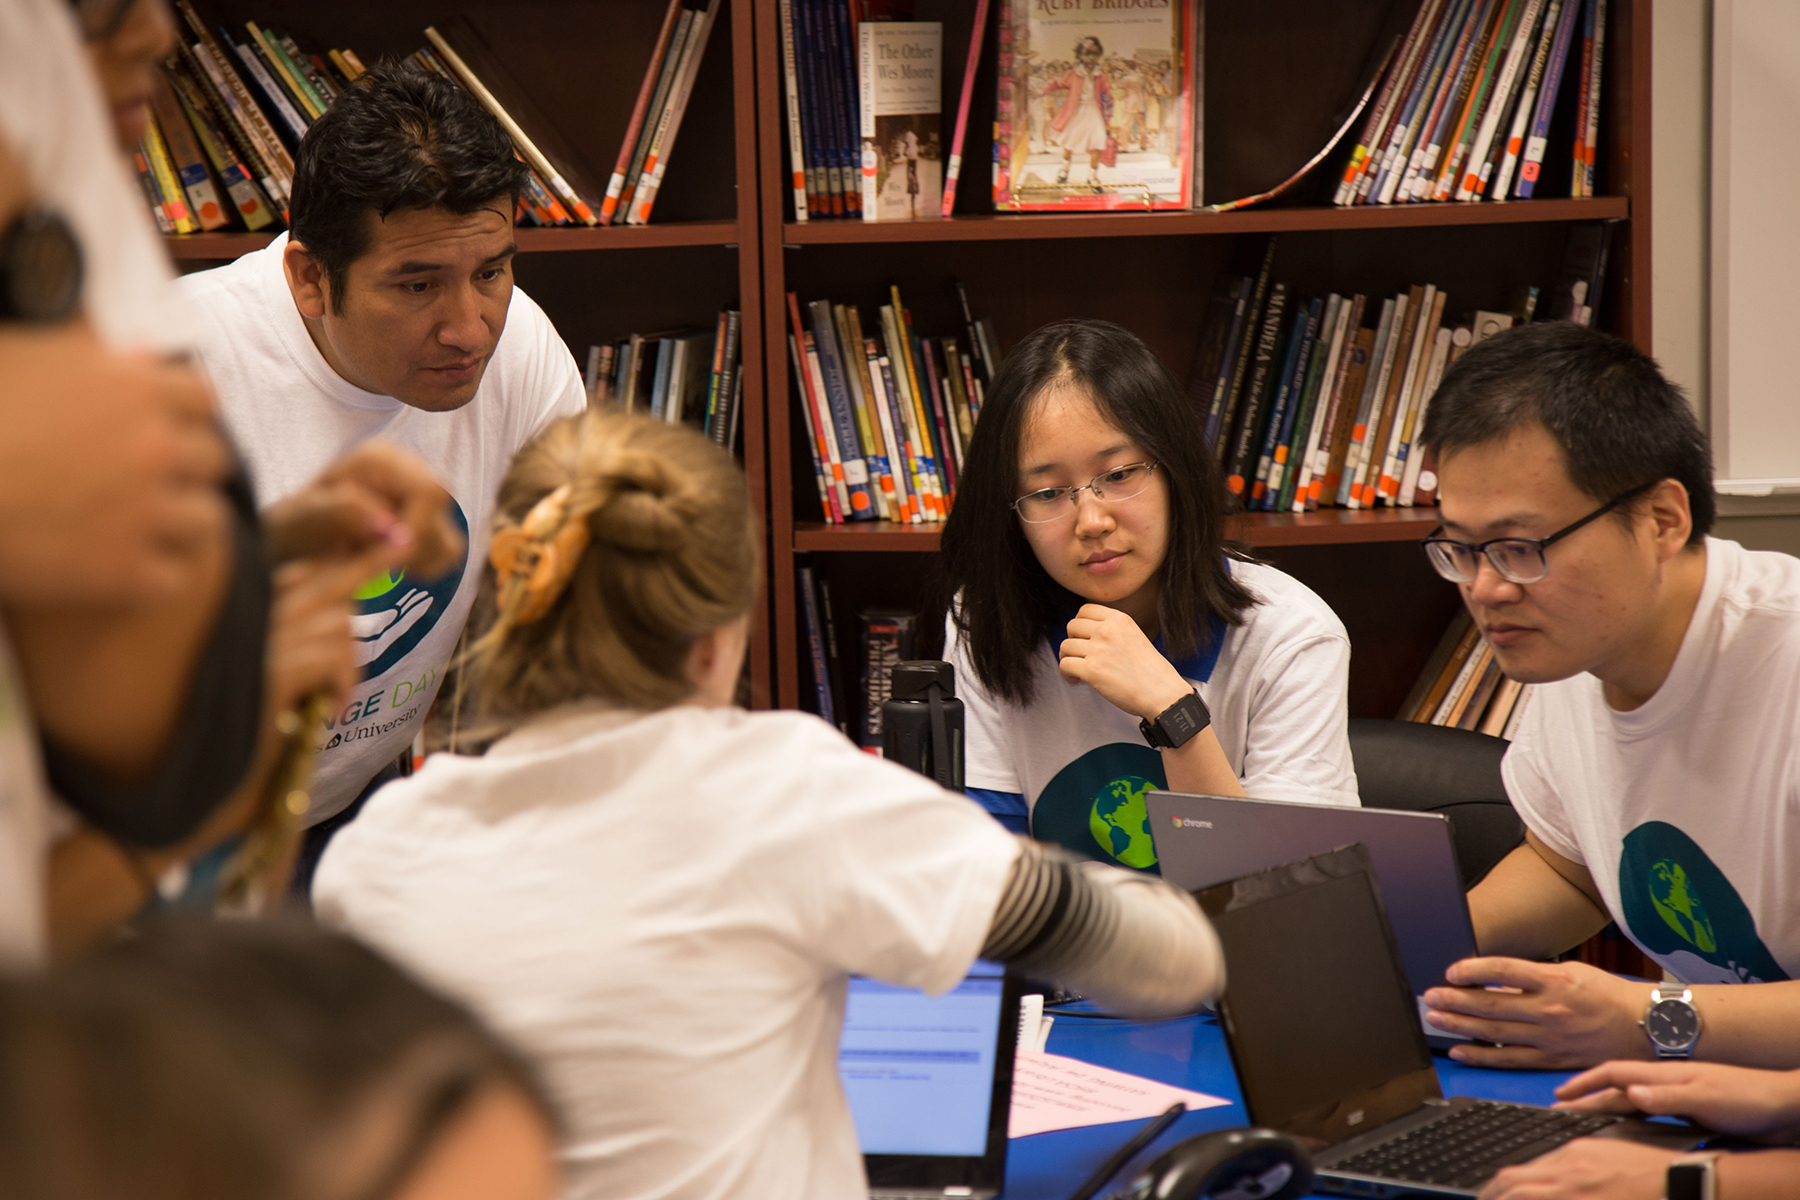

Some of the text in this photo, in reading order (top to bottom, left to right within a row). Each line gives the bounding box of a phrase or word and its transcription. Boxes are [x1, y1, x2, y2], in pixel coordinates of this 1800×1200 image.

[878, 43, 934, 60] The Other
[1526, 30, 1553, 90] SACAGAWEA
[861, 30, 873, 132] The Other Wes Moore
[877, 64, 935, 80] Wes Moore
[1255, 292, 1285, 363] MANDELA
[1254, 366, 1265, 380] The
[1251, 380, 1262, 395] Life
[1243, 403, 1257, 428] Nelson
[1236, 427, 1252, 459] Mandela
[391, 663, 443, 708] DAY
[868, 639, 883, 735] PRESIDENTS
[344, 704, 421, 742] University
[1173, 712, 1189, 732] 11:21
[1183, 818, 1213, 829] chrome
